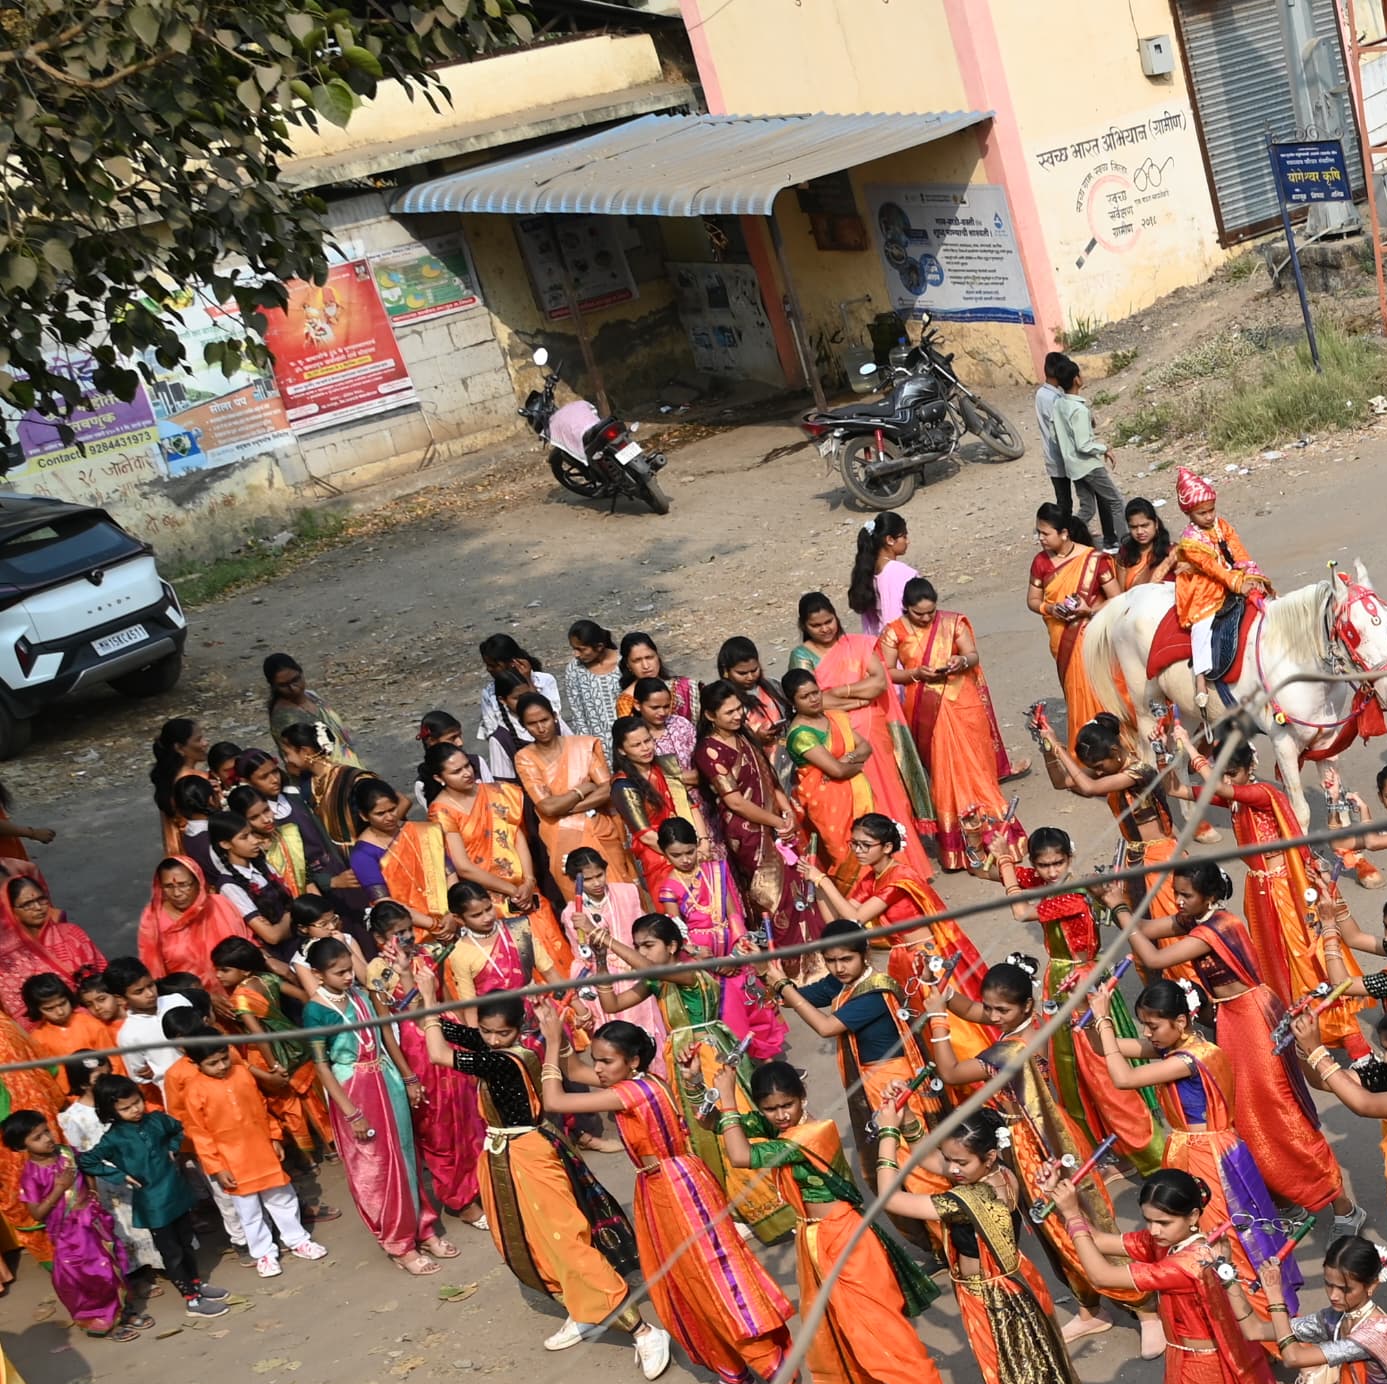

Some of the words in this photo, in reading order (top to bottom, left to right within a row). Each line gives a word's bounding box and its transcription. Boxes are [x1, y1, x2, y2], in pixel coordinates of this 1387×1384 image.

[1036, 146, 1069, 172] स्वच्छ
[1070, 138, 1101, 160] भारत
[1101, 126, 1148, 152] अभियान
[1321, 166, 1342, 186] कृषि
[89, 431, 152, 456] 9284431973
